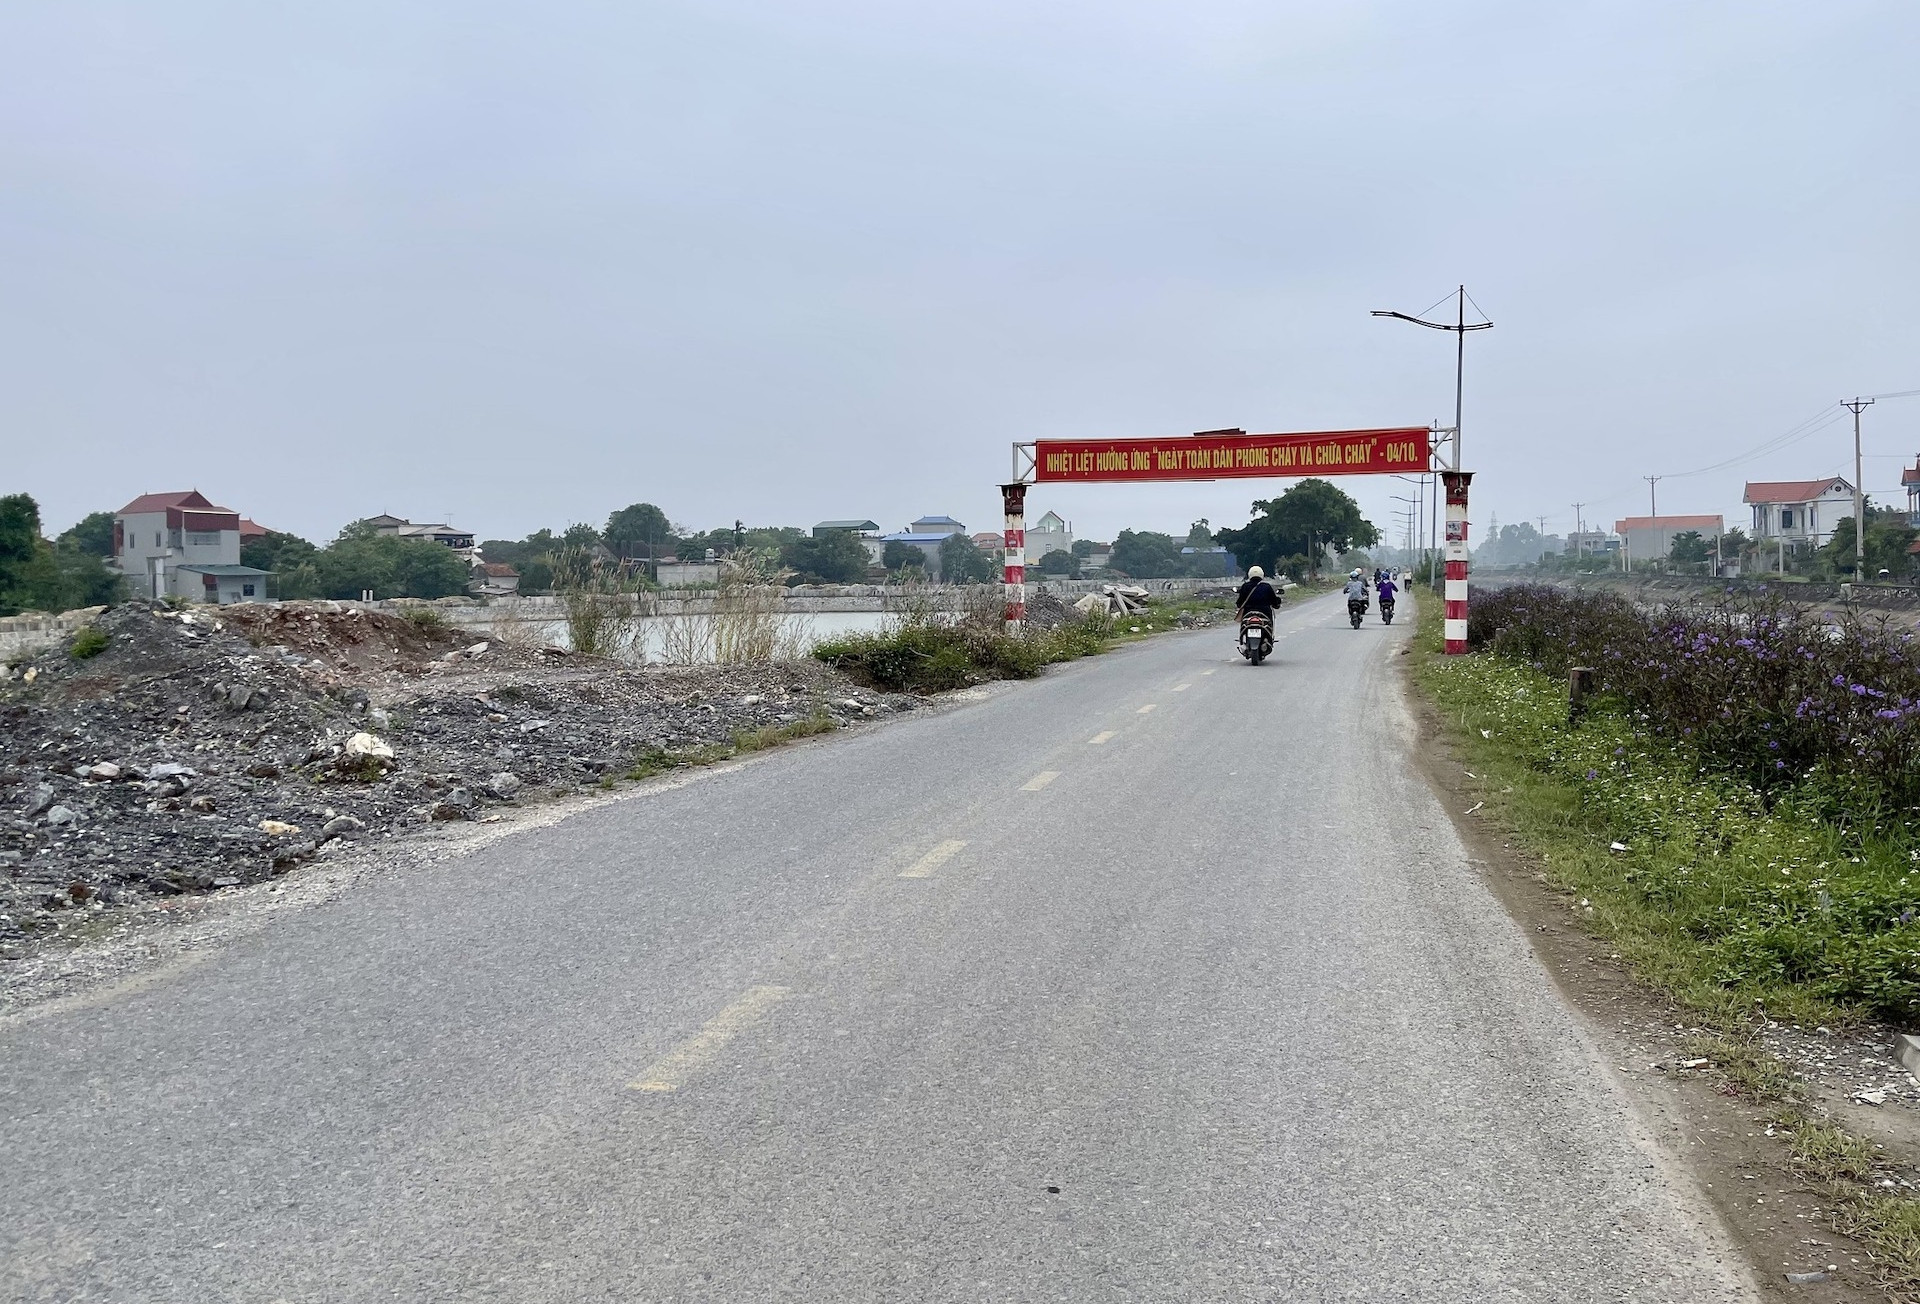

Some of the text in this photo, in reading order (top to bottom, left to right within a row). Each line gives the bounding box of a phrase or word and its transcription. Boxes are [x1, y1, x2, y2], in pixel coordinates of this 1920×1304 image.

[1046, 449, 1073, 476] NHIỆT
[1075, 449, 1094, 476] LIỆT
[1096, 446, 1128, 472] HƯỞNG
[1131, 448, 1150, 471] ỨNG
[1185, 446, 1211, 469] TOÀN
[1213, 445, 1233, 468] DÂN
[1236, 443, 1269, 467] PHÒNG
[1272, 443, 1297, 466] CHÁY
[1300, 442, 1313, 466] VÀ
[1315, 441, 1342, 465] CHỮA
[1386, 442, 1418, 463] 04/10.
